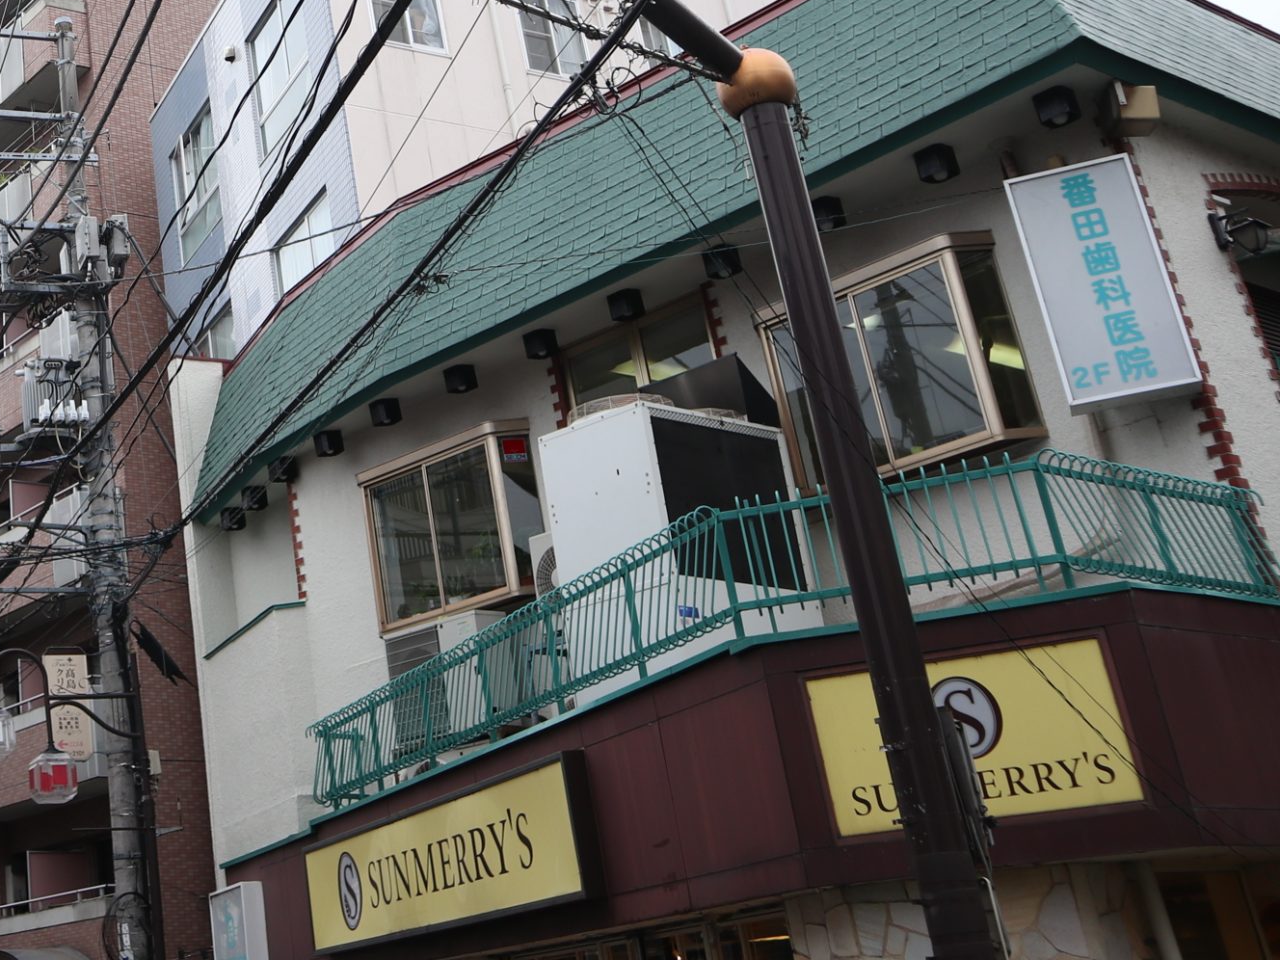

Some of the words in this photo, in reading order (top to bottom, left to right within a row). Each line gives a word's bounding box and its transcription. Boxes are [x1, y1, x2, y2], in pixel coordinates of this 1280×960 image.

[1060, 172, 1158, 384] 番田歯科医院
[1071, 361, 1110, 389] 2F
[851, 751, 1116, 816] SUERRY'S
[368, 808, 533, 909] SUNMERRY'S
